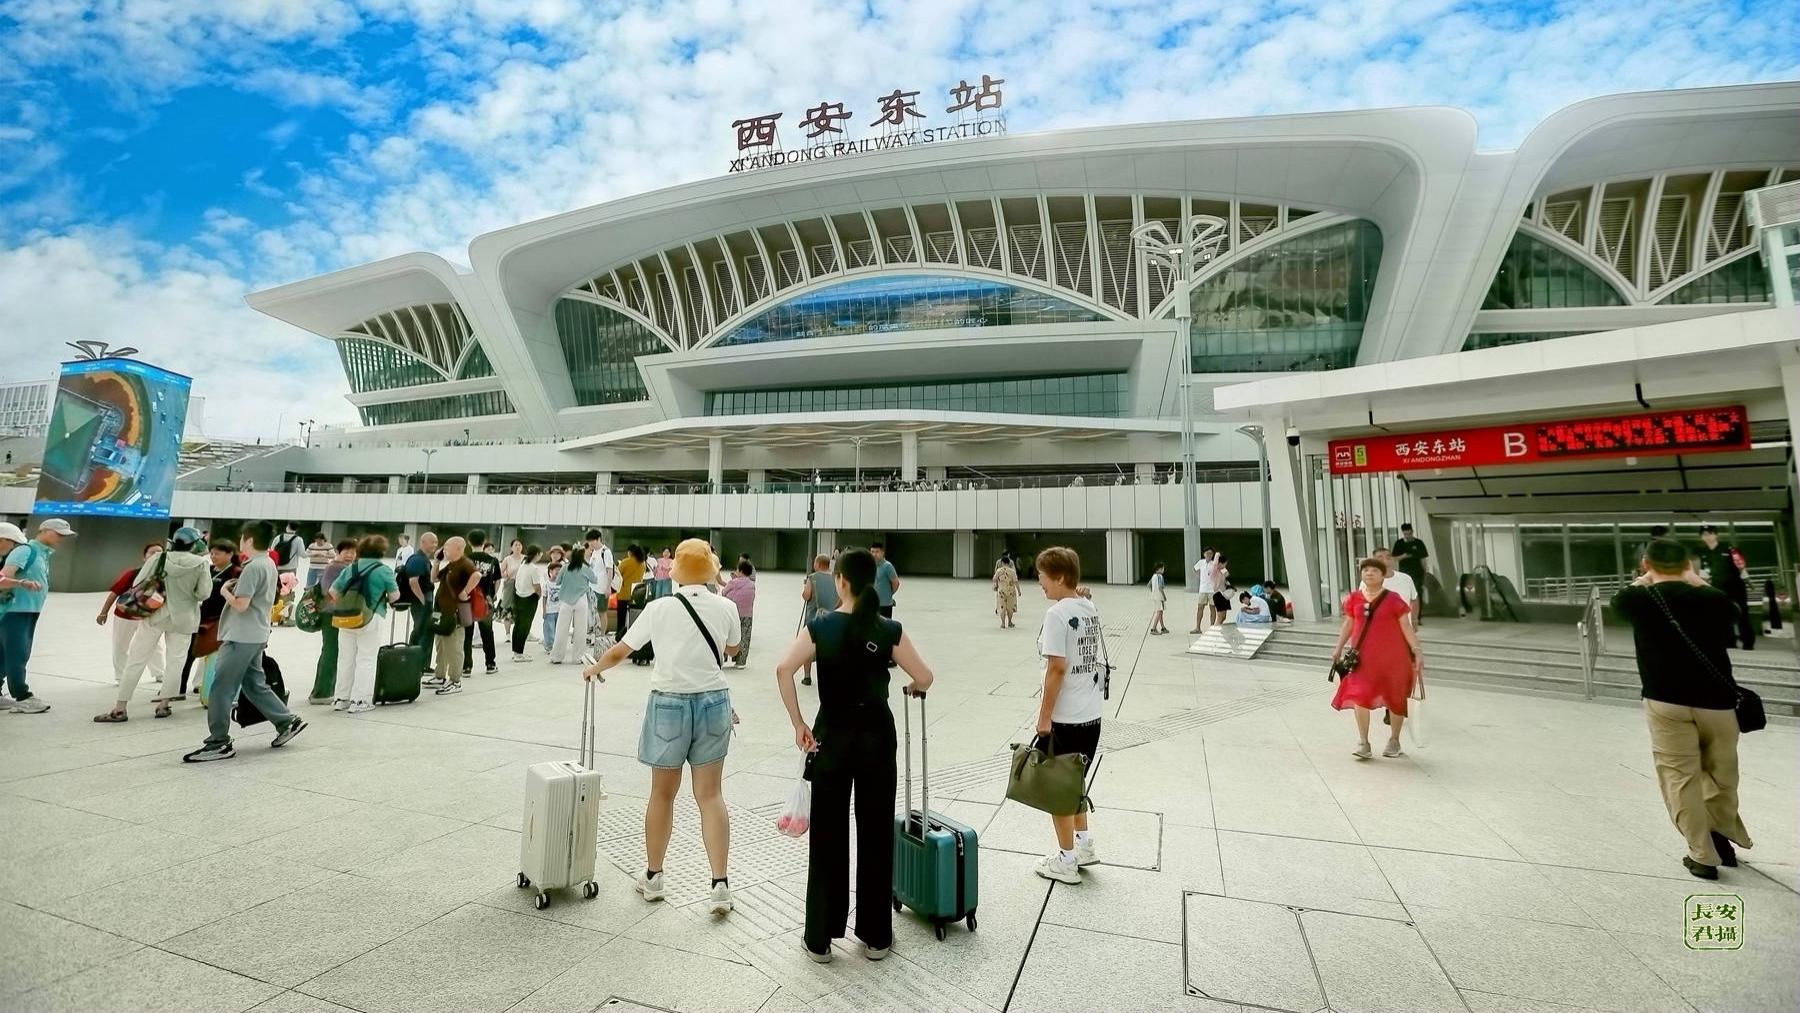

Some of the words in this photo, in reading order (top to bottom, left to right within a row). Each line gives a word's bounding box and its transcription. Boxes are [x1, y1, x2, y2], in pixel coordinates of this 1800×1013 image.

[732, 75, 1004, 150] 西安东站
[729, 145, 826, 172] XI'ANDONG
[833, 131, 916, 157] RAILWAY
[923, 118, 1007, 143] STATION
[1356, 447, 1364, 457] 5
[1395, 438, 1466, 456] 西安东站
[1503, 432, 1528, 457] B
[1078, 645, 1092, 656] LOSE
